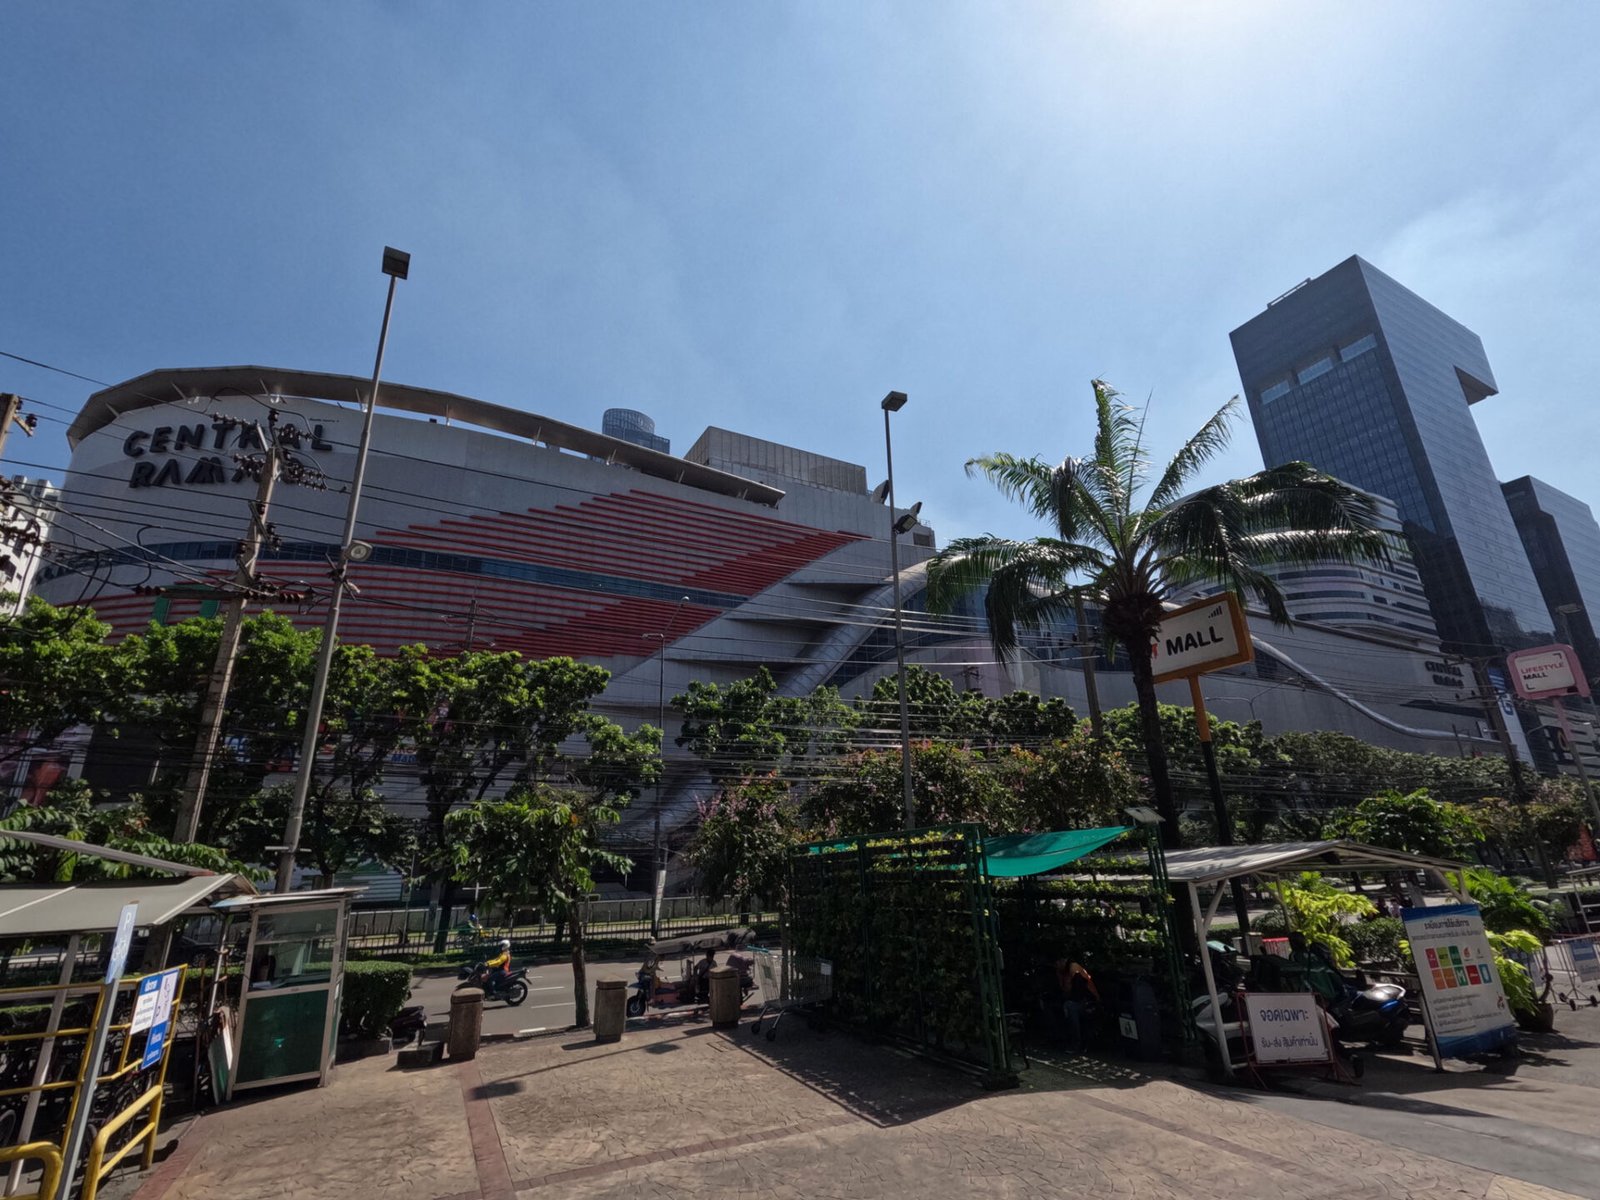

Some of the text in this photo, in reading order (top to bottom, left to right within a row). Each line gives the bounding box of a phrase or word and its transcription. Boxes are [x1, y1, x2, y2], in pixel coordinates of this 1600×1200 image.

[124, 423, 333, 457] CENTRAL
[1166, 626, 1224, 656] MALL
[1520, 662, 1565, 674] LIFESTYLE
[1523, 671, 1548, 680] MALL
[1260, 1009, 1309, 1022] จอดเฉพาะ
